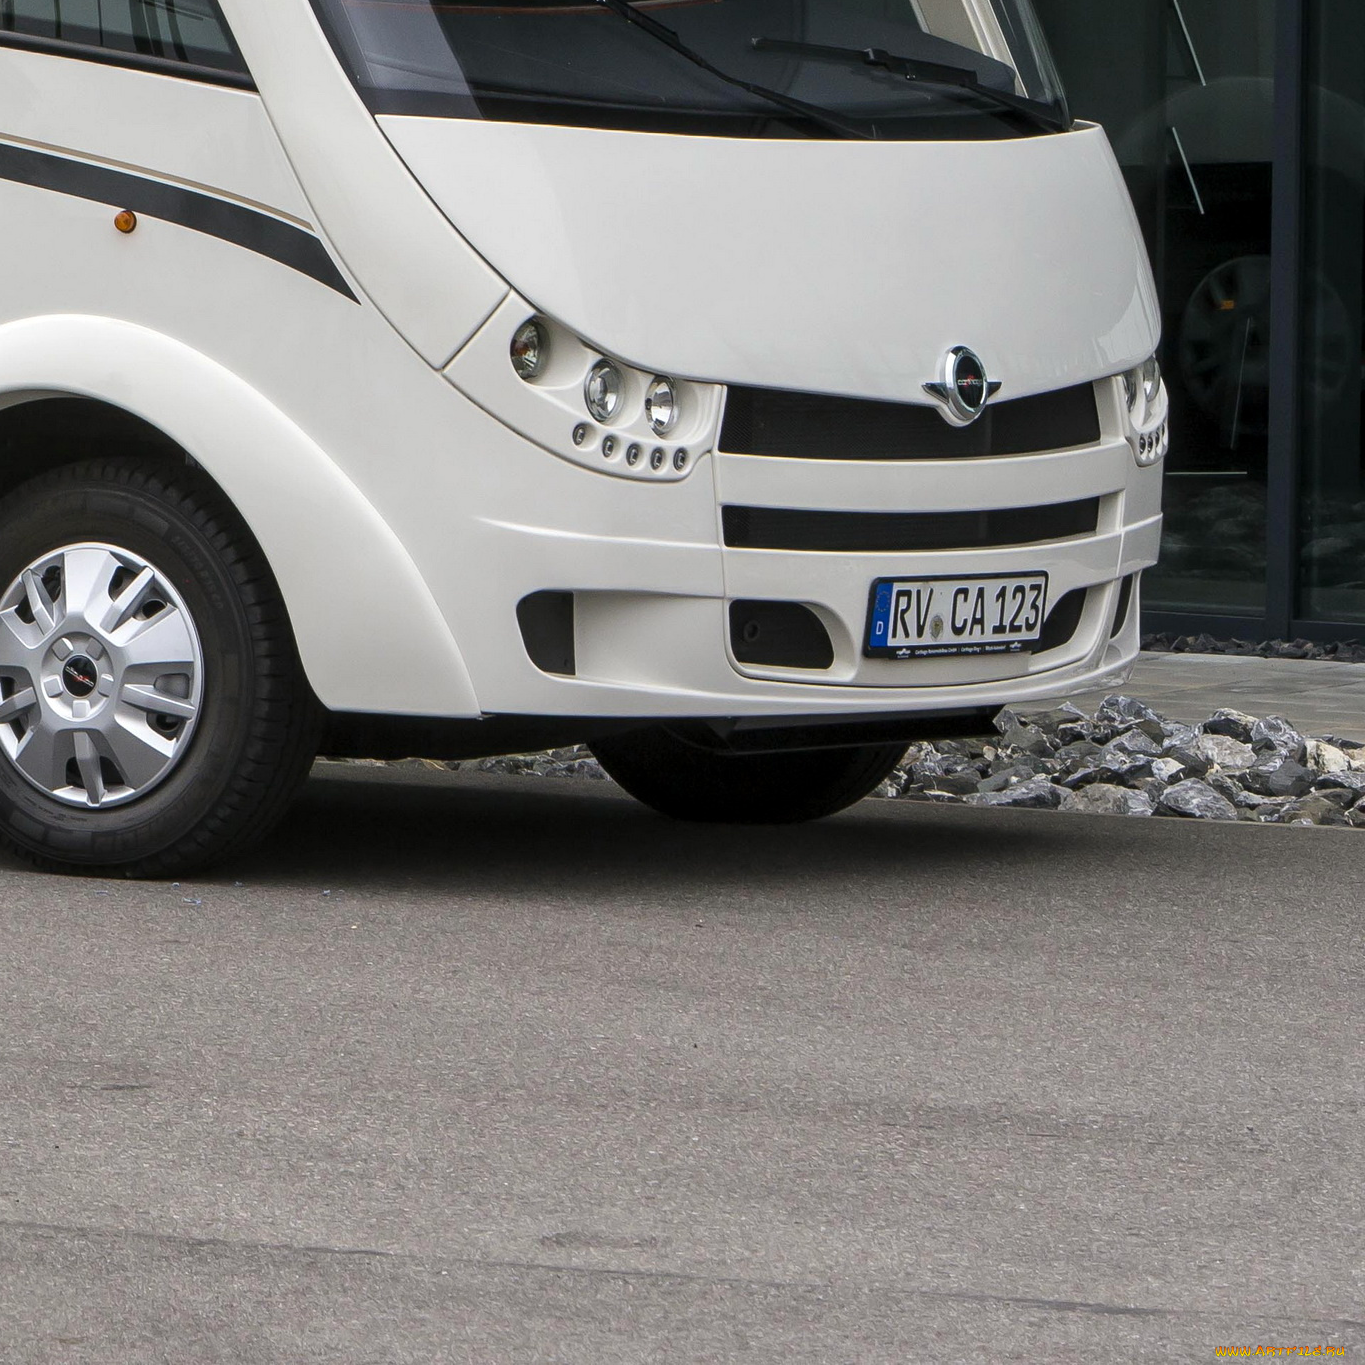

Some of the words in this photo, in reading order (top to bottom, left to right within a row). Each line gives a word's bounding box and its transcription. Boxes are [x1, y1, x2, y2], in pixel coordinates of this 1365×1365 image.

[875, 620, 884, 635] D
[891, 587, 934, 639] RV
[950, 586, 986, 636] CA
[991, 583, 1043, 634] 123
